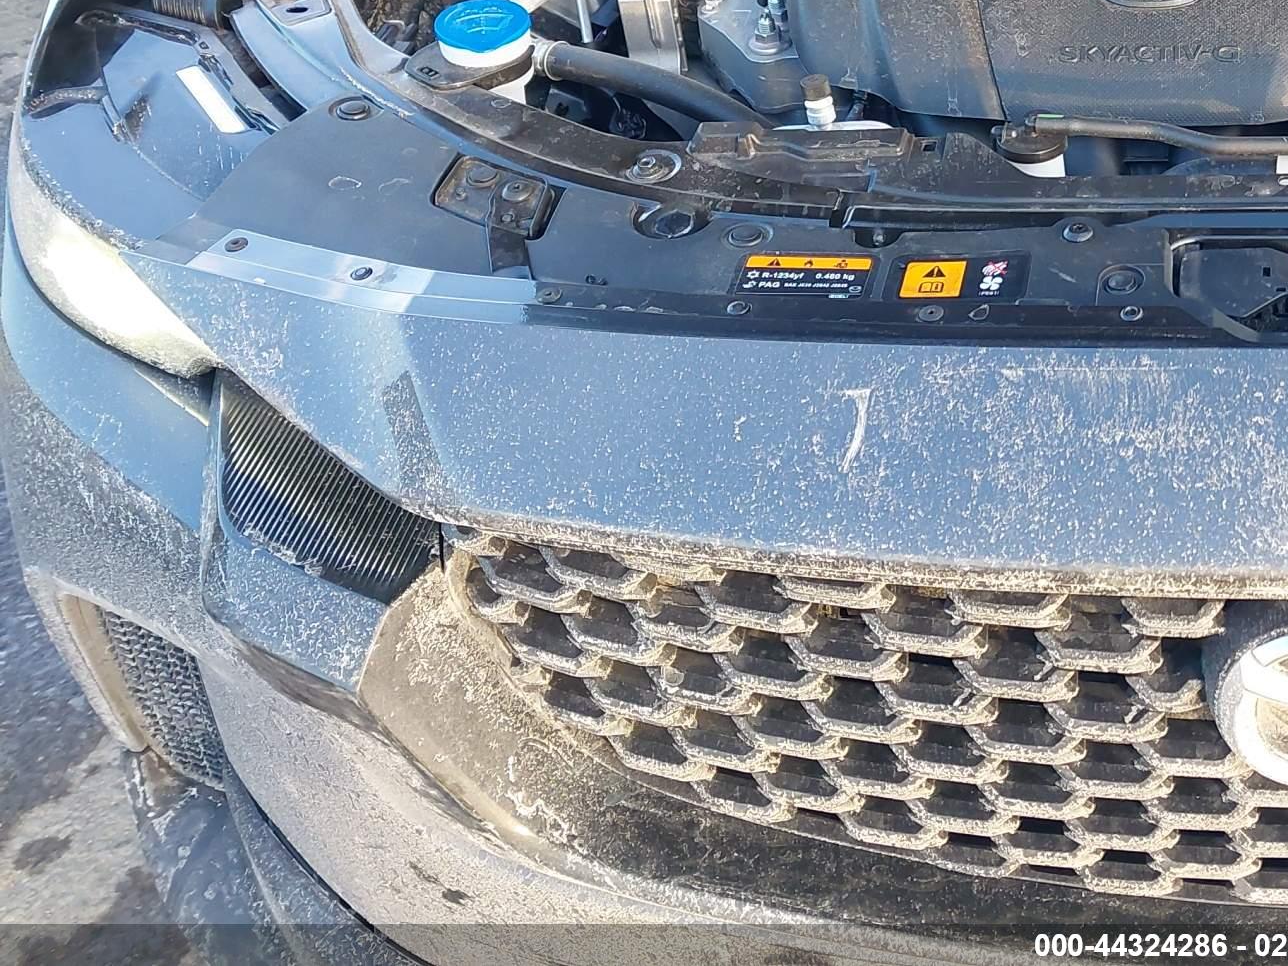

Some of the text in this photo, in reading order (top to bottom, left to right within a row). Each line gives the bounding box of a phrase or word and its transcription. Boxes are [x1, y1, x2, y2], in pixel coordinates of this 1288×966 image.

[1058, 44, 1241, 63] SKYACTIV-G
[761, 271, 805, 280] R-1234yf
[842, 273, 855, 282] kg
[758, 281, 781, 289] PAG
